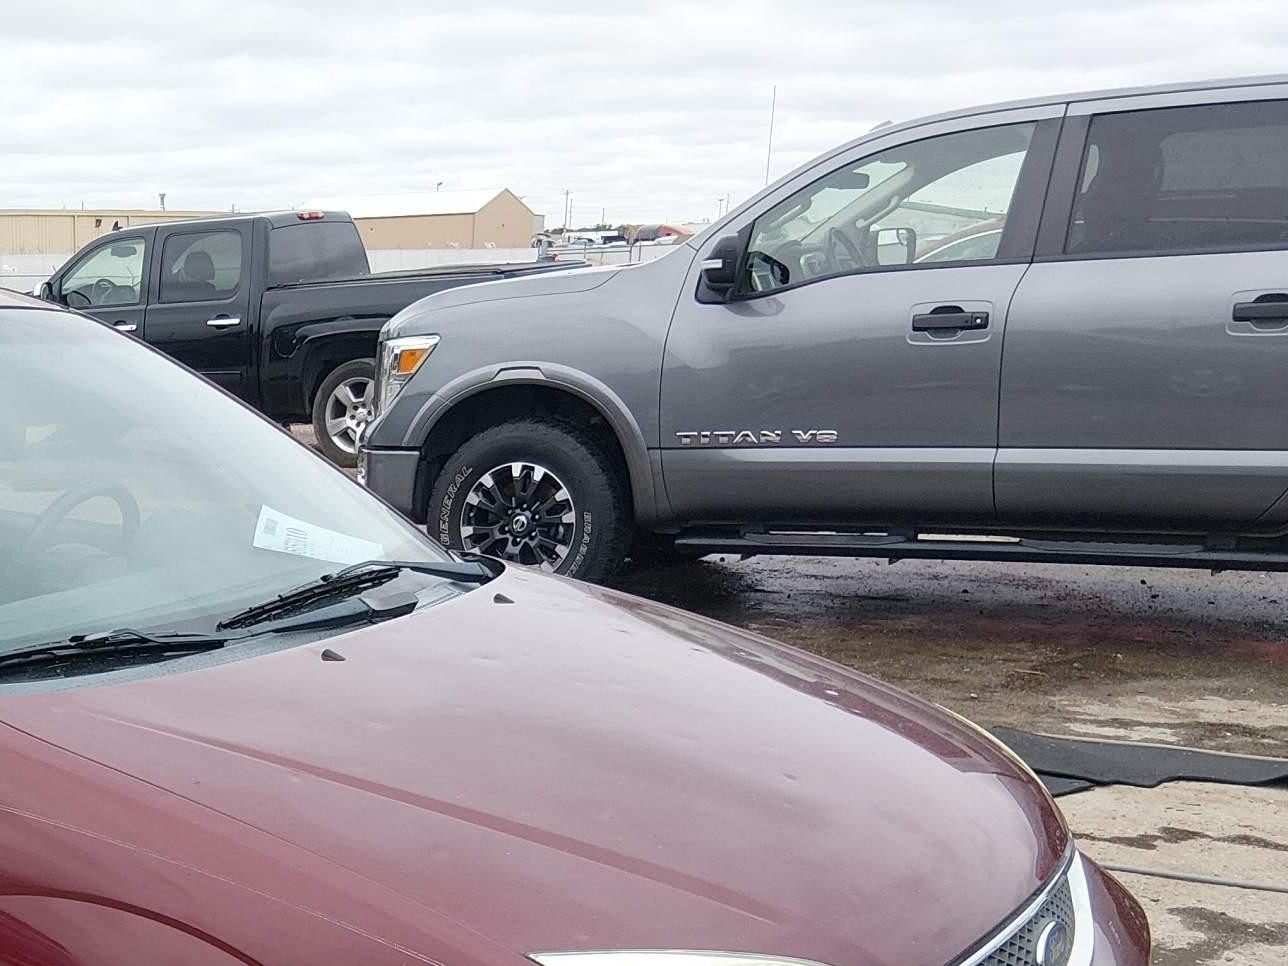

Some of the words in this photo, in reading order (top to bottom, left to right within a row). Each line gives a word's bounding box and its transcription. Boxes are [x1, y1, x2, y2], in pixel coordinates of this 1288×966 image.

[676, 430, 781, 444] TITAN
[791, 430, 838, 443] V8
[439, 466, 473, 545] GENERAL
